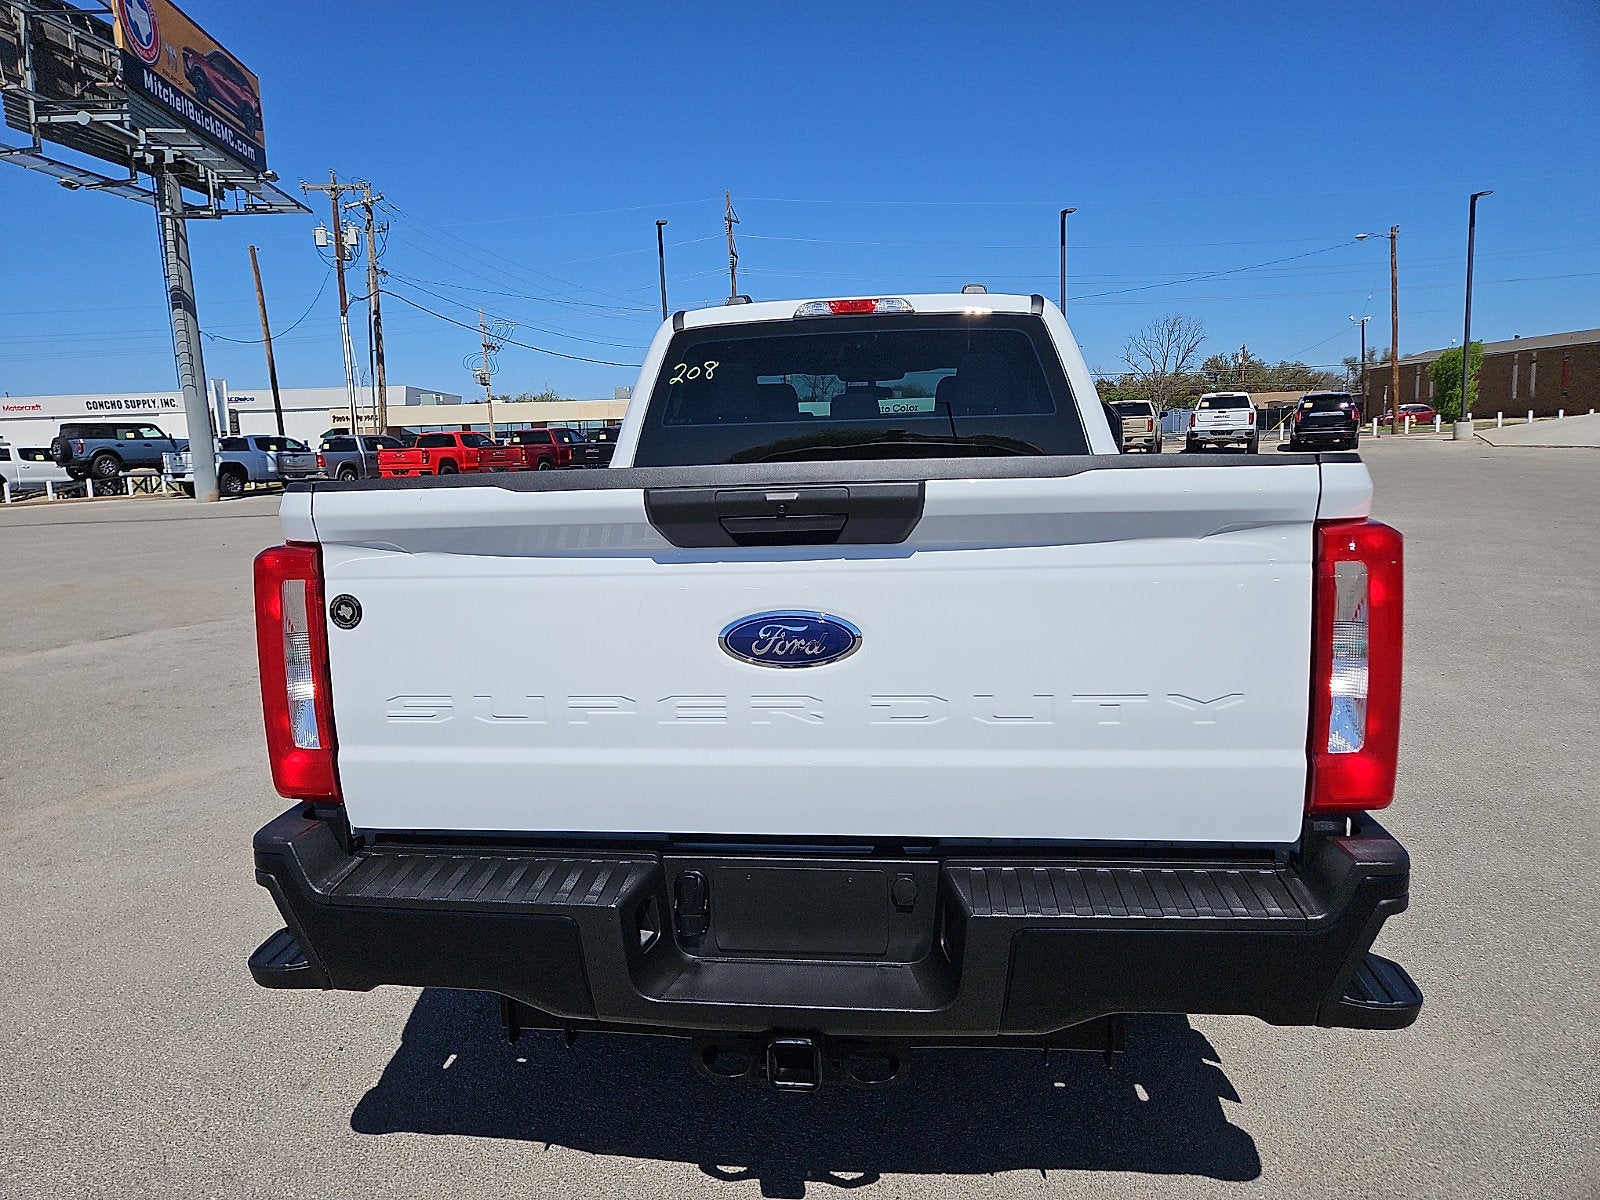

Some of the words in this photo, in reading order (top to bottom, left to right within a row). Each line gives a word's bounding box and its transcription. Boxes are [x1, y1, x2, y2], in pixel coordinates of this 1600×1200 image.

[143, 69, 256, 161] MitchellBuickGMC.com
[669, 361, 720, 384] 208
[86, 400, 123, 410] CONCHO
[160, 398, 179, 408] INC.
[892, 404, 919, 412] Color
[751, 624, 828, 656] Ford
[387, 695, 823, 725] SUPER
[871, 693, 1244, 725] DUTY
